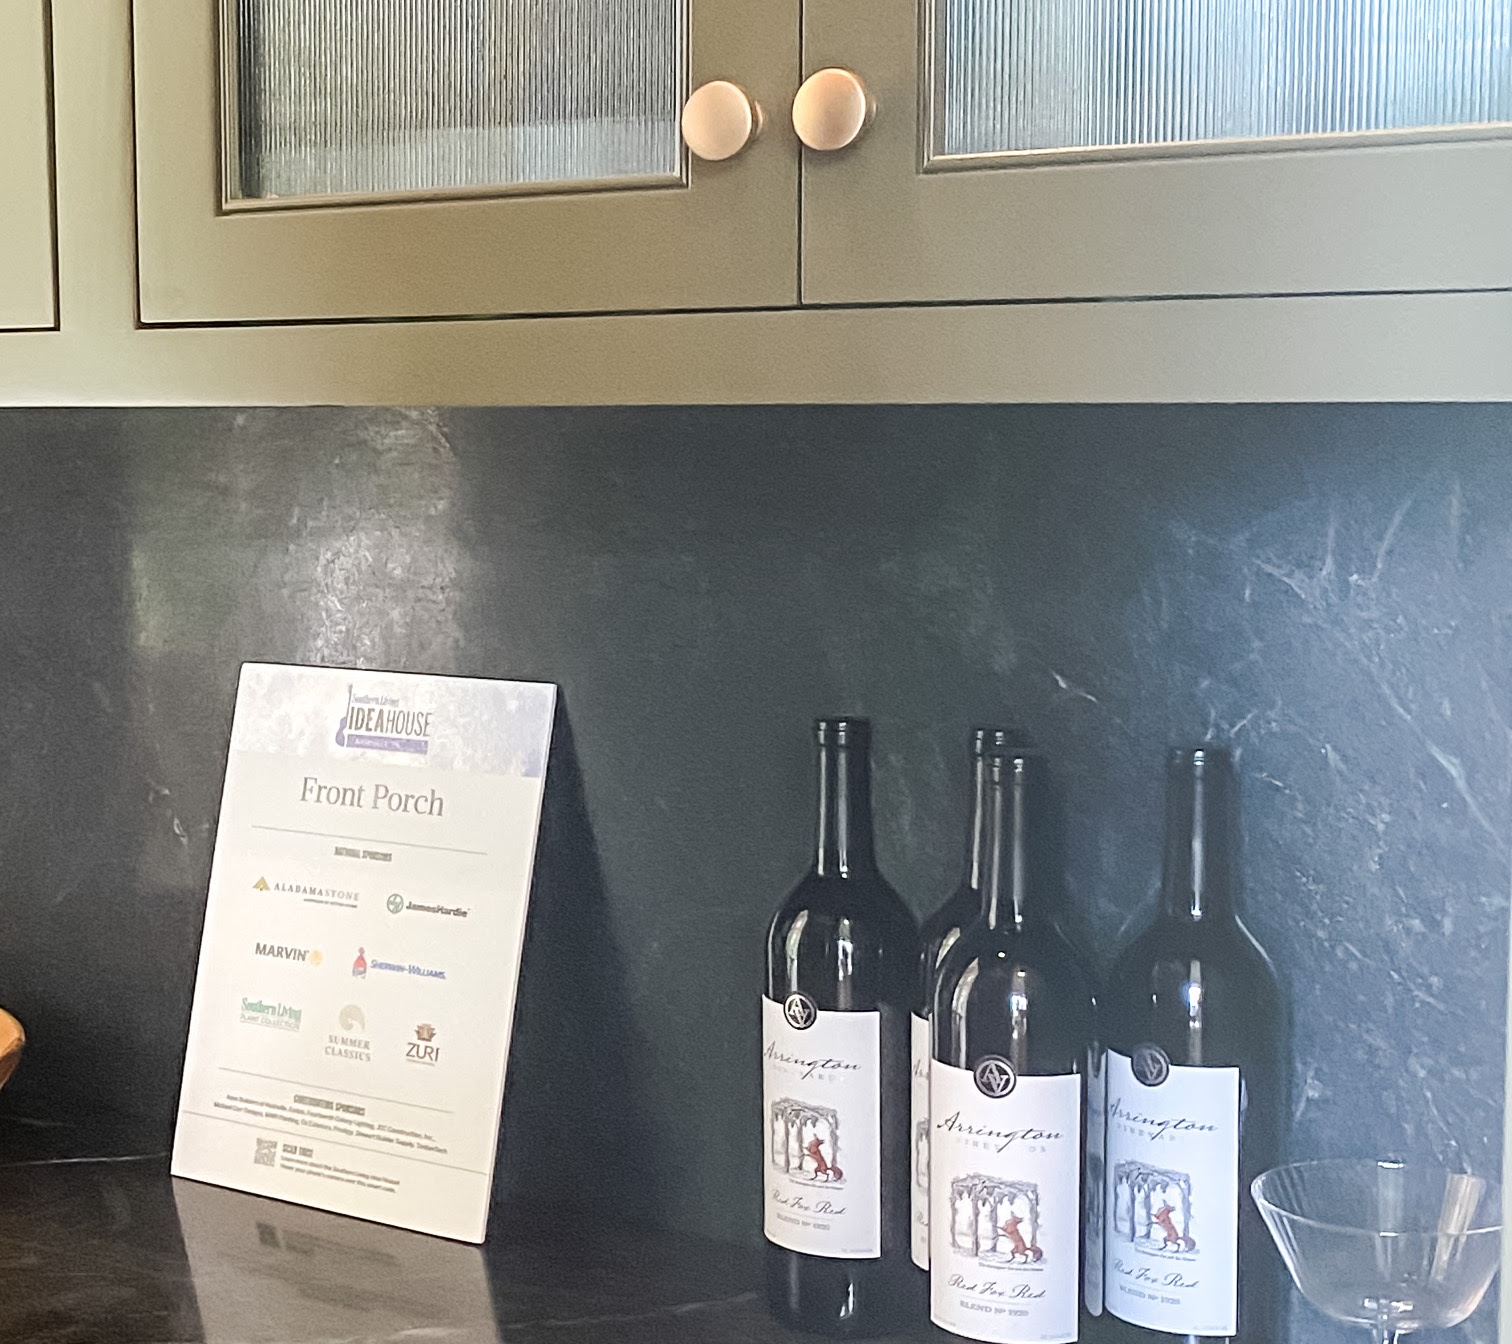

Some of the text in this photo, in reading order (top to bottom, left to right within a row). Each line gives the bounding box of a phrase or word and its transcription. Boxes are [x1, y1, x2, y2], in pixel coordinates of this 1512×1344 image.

[299, 776, 445, 817] Front Porch
[255, 942, 309, 963] MARVIN
[241, 997, 276, 1016] Southern
[328, 1034, 371, 1051] SUMMER
[405, 1041, 441, 1063] ZURI
[324, 1045, 372, 1063] CLASSICS
[764, 1041, 862, 1081] Arrington
[1110, 1097, 1218, 1141] Arrington
[937, 1110, 1065, 1154] Arrington
[813, 1200, 847, 1215] Red
[948, 1273, 1047, 1299] Red Fox Red
[1162, 1272, 1200, 1288] Red
